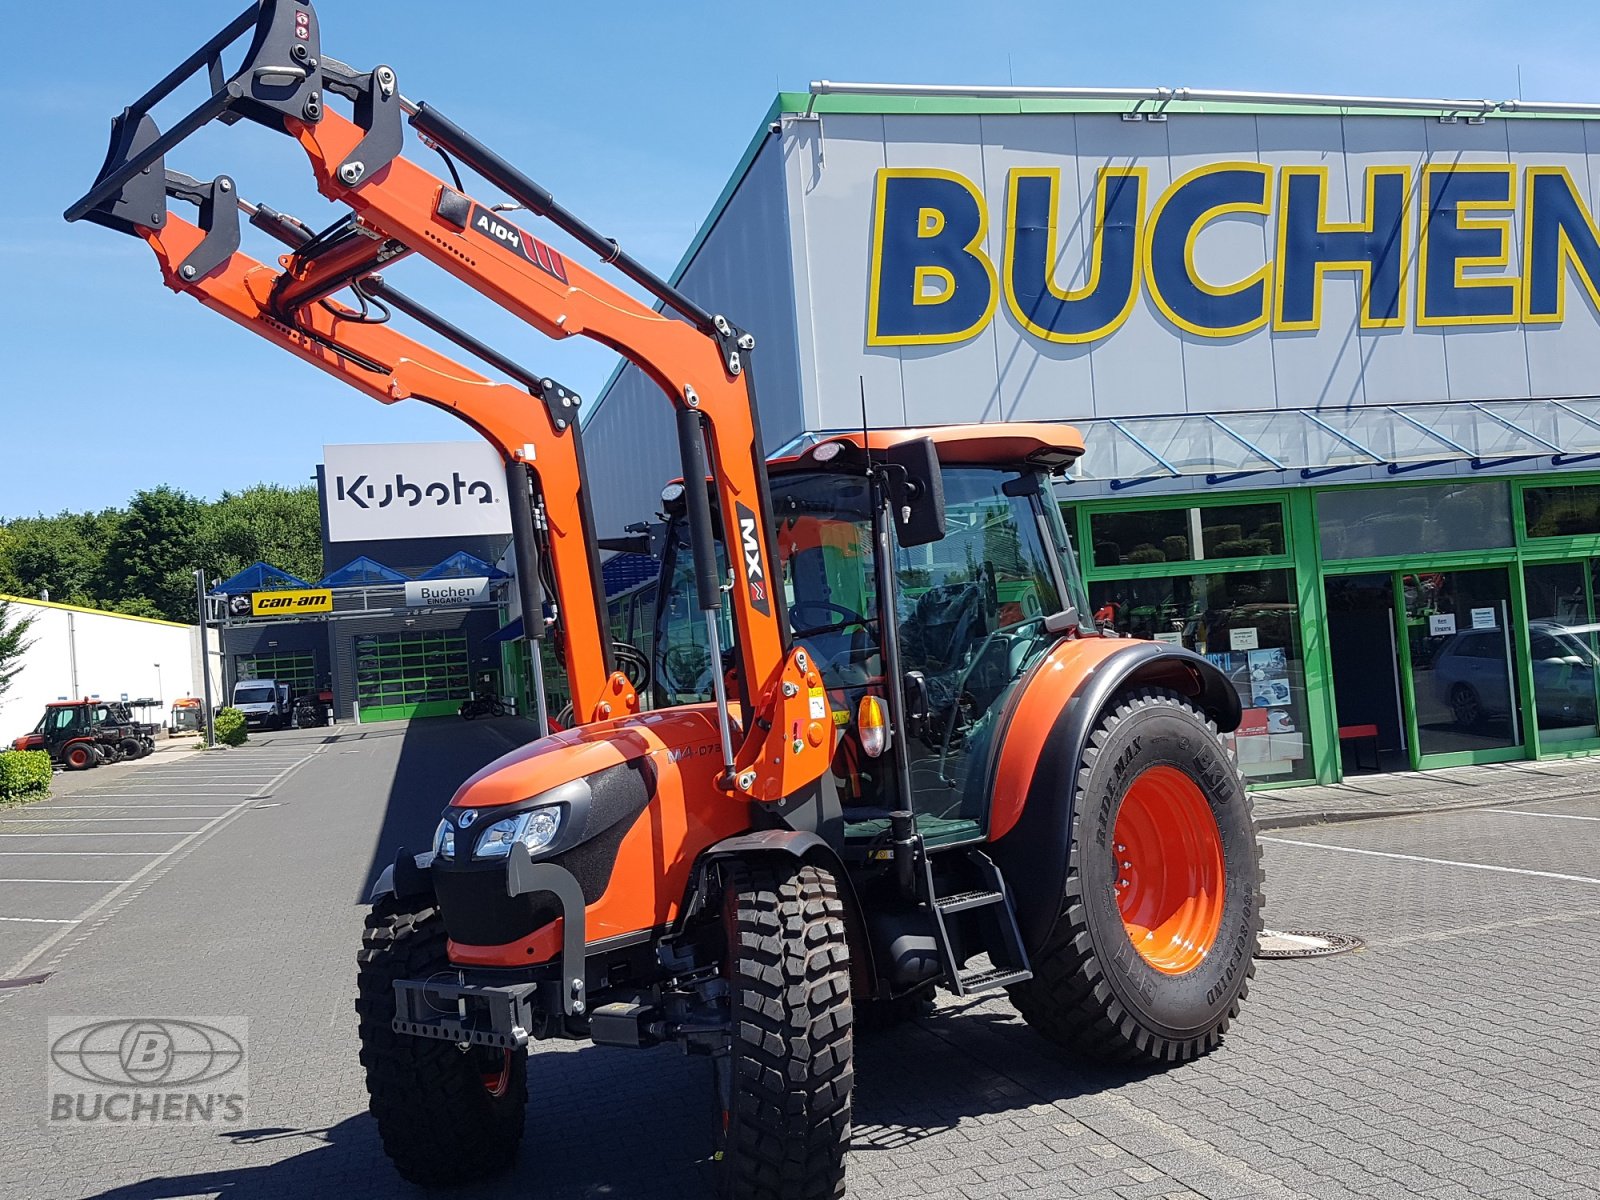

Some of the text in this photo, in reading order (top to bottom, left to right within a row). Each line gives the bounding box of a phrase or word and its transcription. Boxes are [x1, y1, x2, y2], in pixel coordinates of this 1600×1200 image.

[477, 215, 519, 248] A104
[336, 472, 493, 509] Kubota
[740, 518, 763, 579] MX
[258, 595, 327, 608] can-am
[421, 586, 475, 599] Buchen
[427, 597, 463, 605] EINGANG
